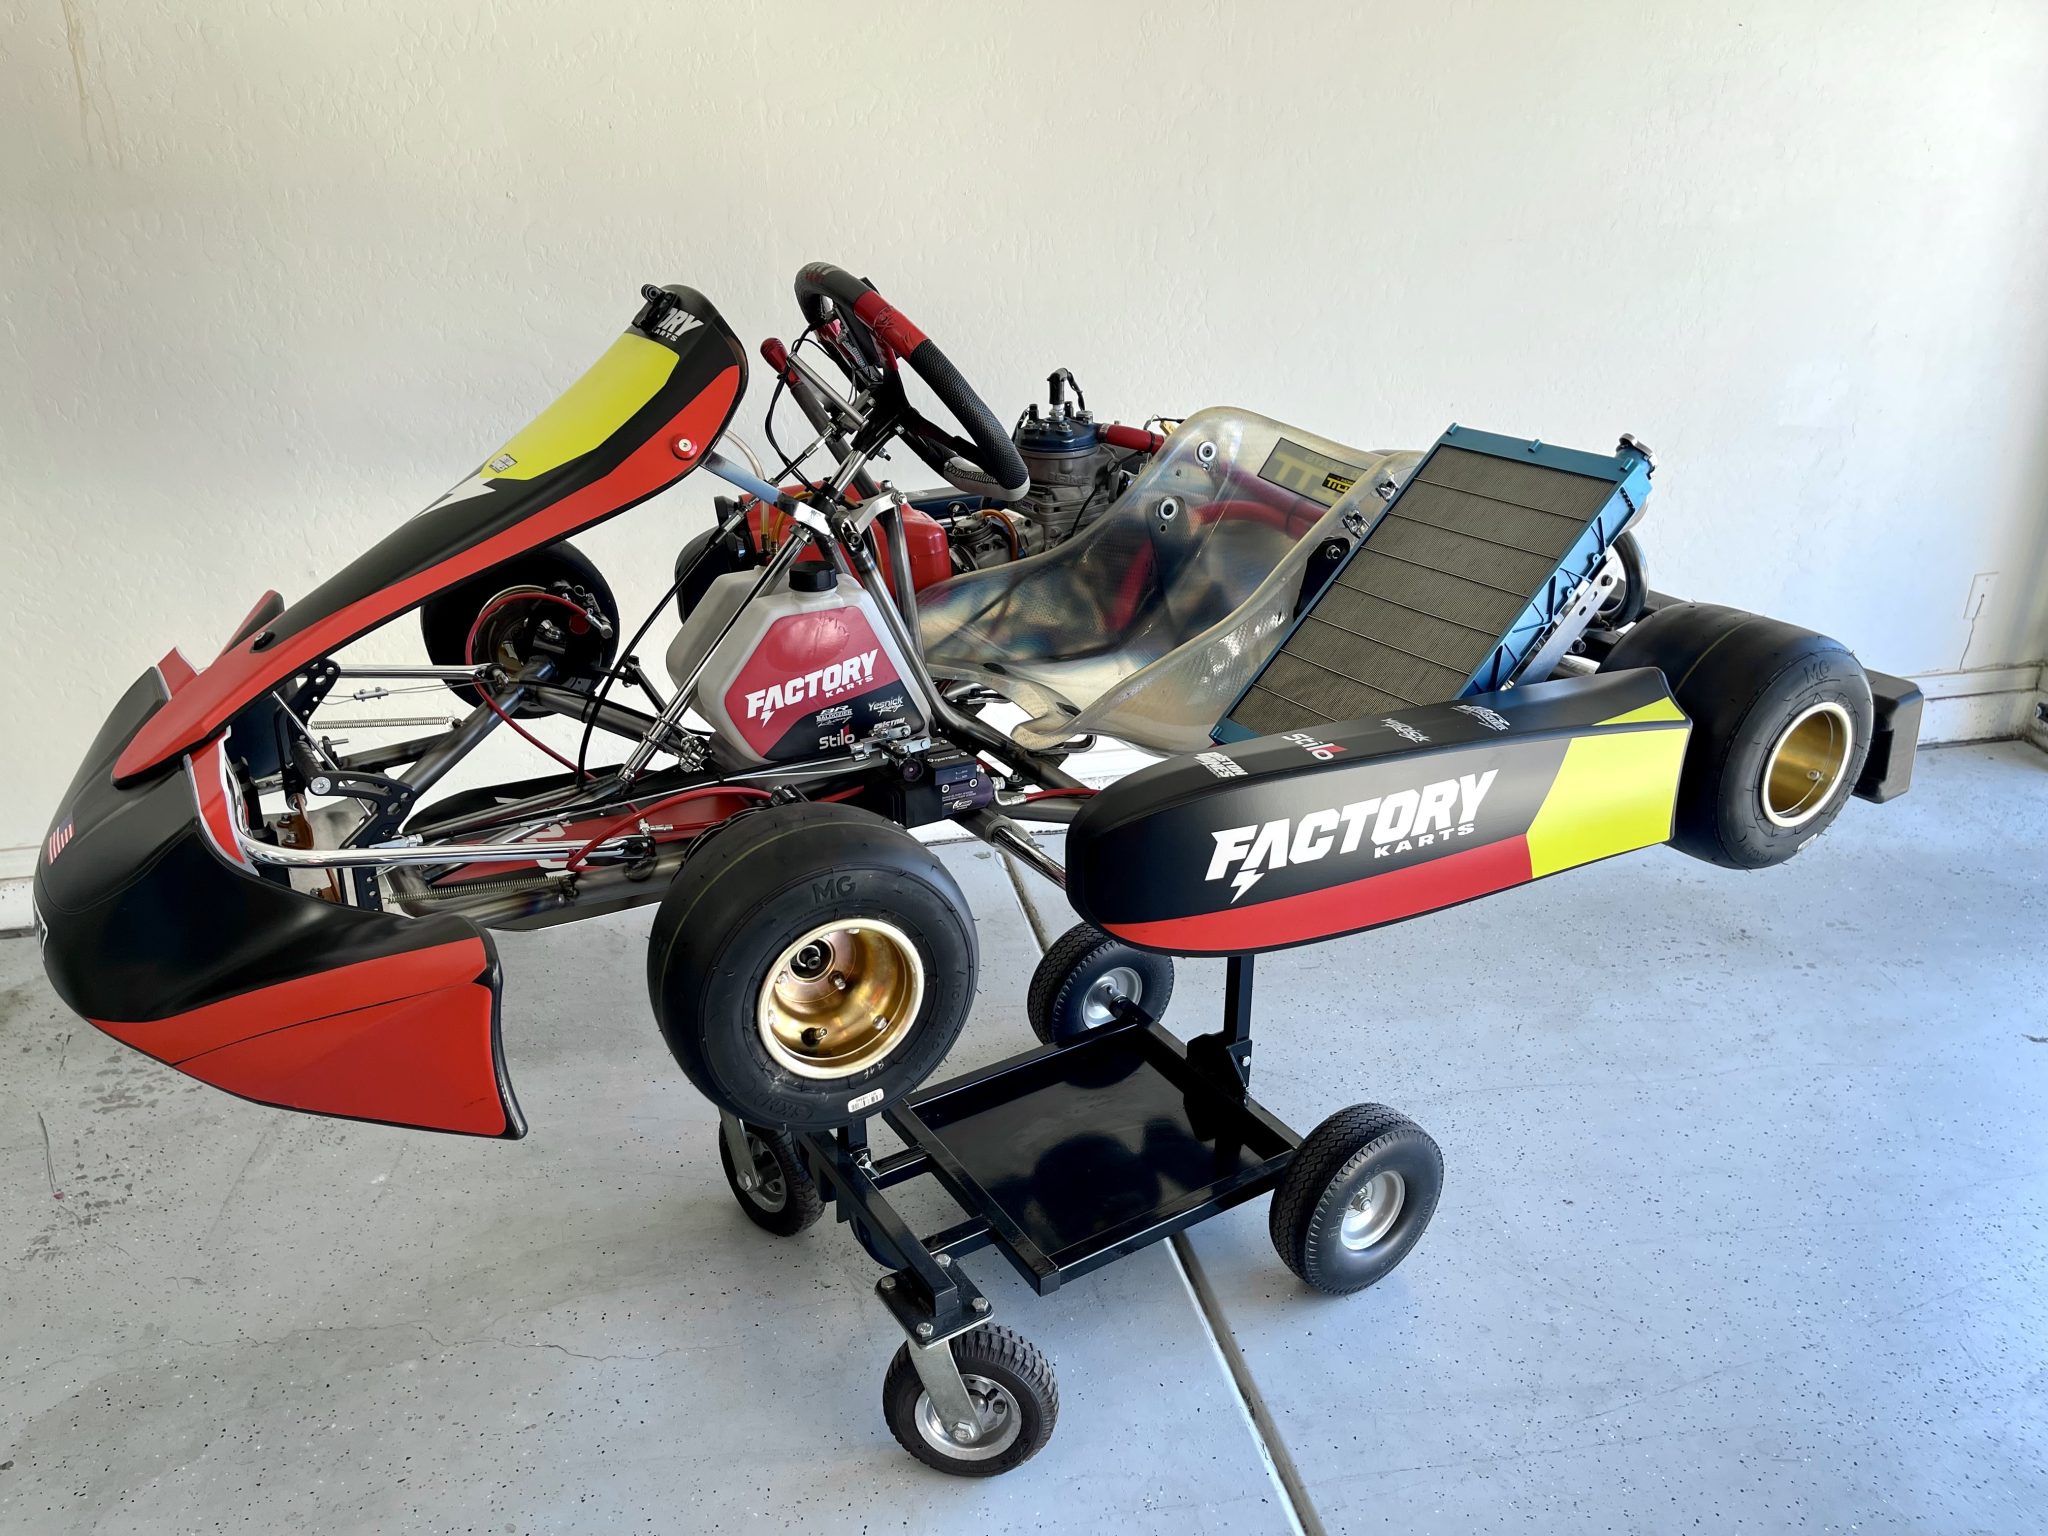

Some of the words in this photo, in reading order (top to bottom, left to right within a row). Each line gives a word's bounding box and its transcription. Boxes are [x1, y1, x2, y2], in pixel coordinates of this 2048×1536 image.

[745, 648, 878, 727] FACTORY
[826, 675, 874, 698] KARTS
[819, 728, 856, 750] Stilo
[1282, 732, 1335, 761] Stilo
[1205, 768, 1499, 903] FACTORY
[1374, 822, 1476, 859] KARTS
[811, 876, 857, 903] MG
